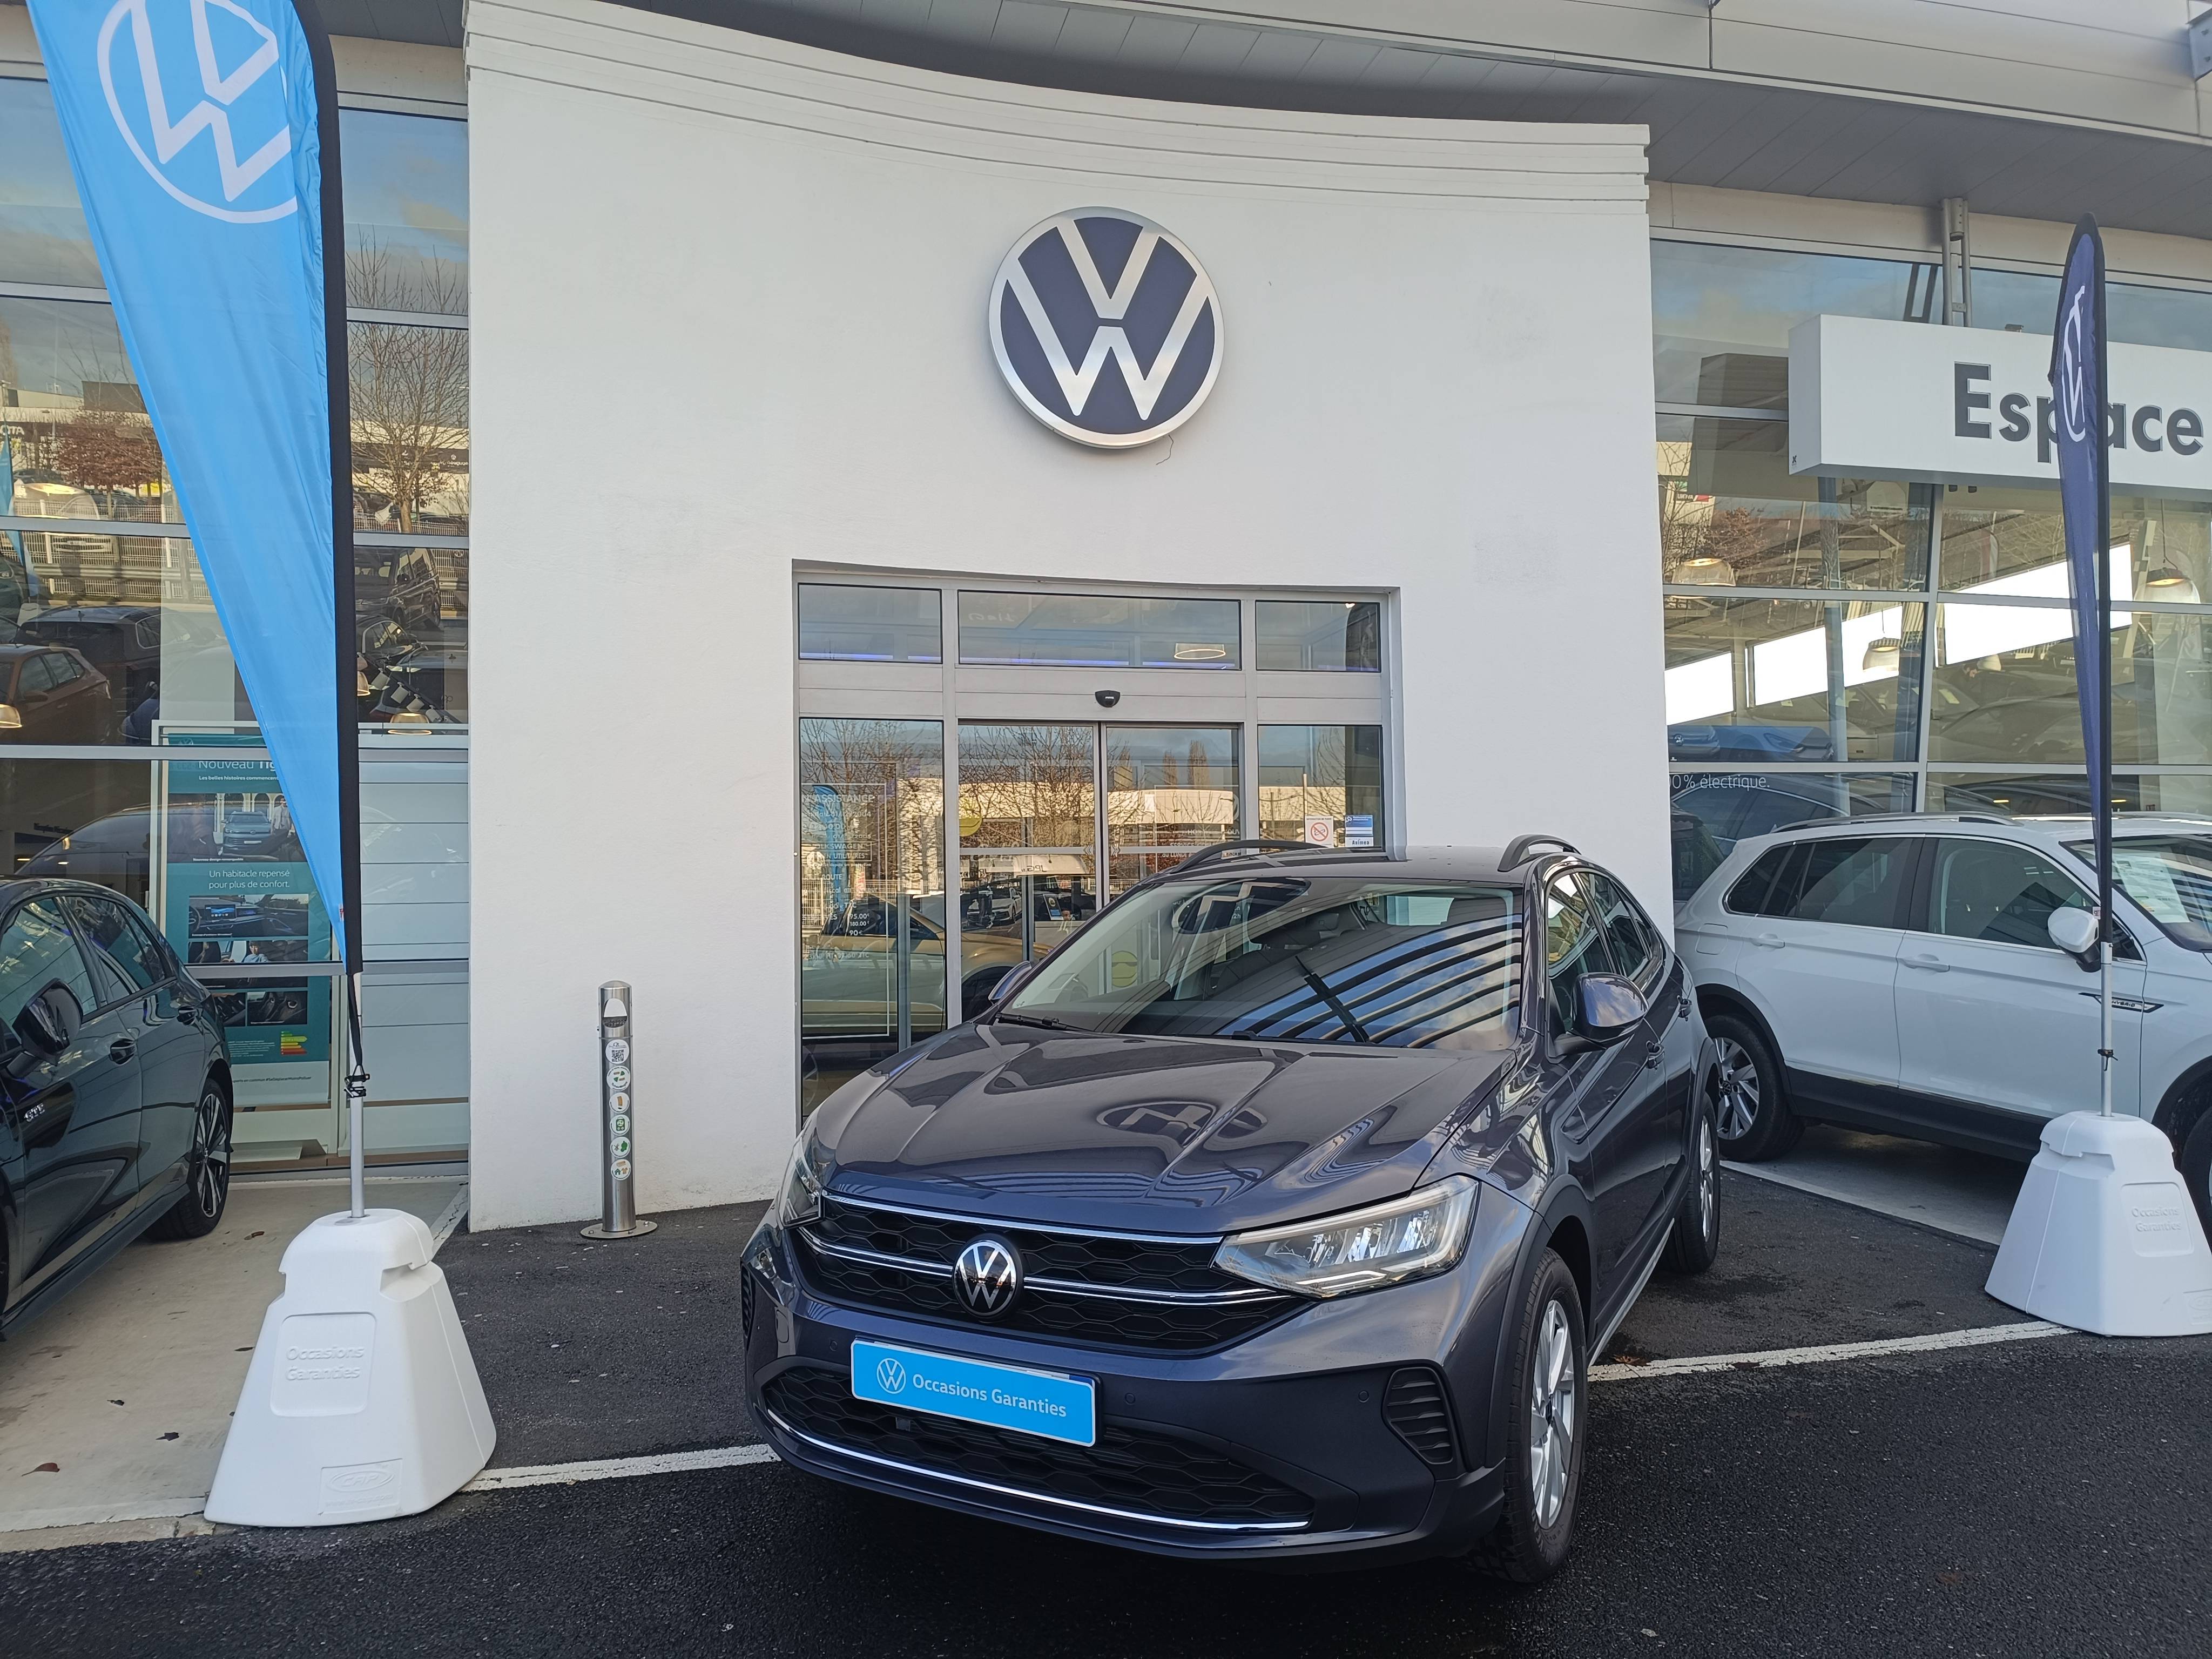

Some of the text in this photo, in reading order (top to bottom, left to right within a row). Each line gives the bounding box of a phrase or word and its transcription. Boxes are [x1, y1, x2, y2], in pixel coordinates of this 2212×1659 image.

[198, 760, 254, 770] Nouveau
[1700, 774, 1770, 791] électrique.
[815, 794, 874, 803] ASSISTANCE
[259, 869, 290, 879] repensé
[208, 882, 228, 890] pour
[229, 881, 246, 889] plus
[24, 1103, 45, 1122] GTE
[2131, 1206, 2180, 1217] Occasions
[2135, 1220, 2182, 1232] Garanties
[286, 1345, 365, 1360] Occasions
[285, 1364, 361, 1381] Garanties
[912, 1373, 988, 1401] Occasions
[991, 1388, 1067, 1418] Garanties
